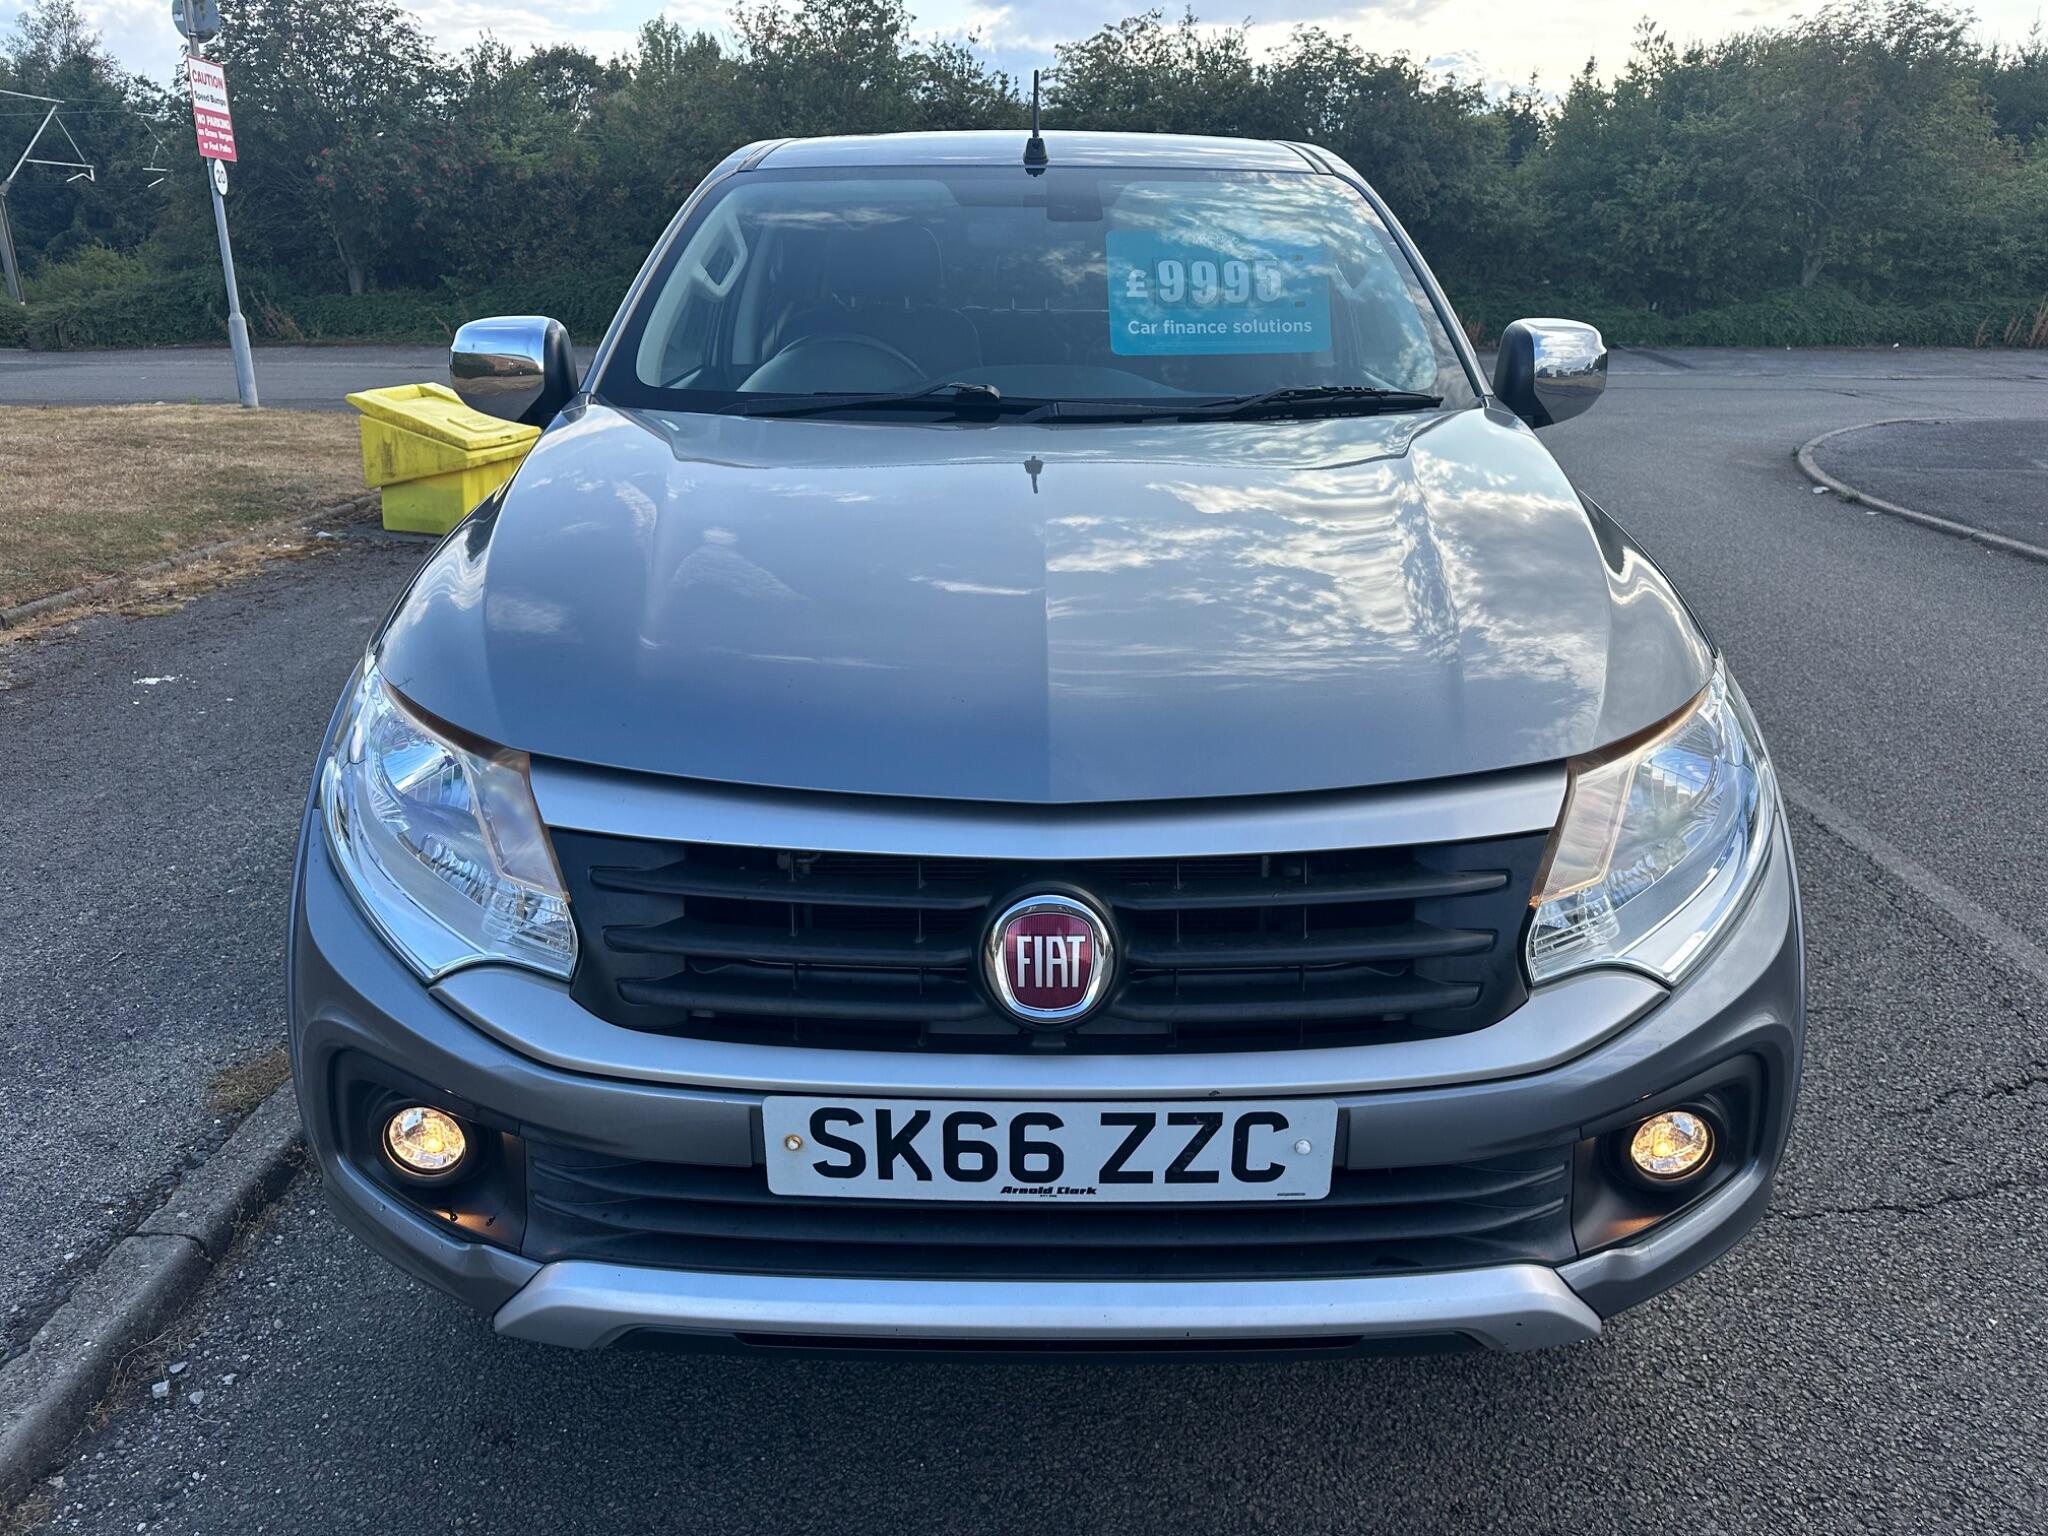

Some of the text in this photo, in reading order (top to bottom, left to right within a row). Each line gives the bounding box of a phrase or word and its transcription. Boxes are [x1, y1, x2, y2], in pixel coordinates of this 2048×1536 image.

[196, 113, 206, 125] NO
[1127, 318, 1312, 335] Car finance solutions
[1016, 935, 1086, 989] FIAT
[808, 1106, 1290, 1184] SK66 ZZC
[1000, 1186, 1054, 1195] Arnold
[1056, 1186, 1097, 1196] Clark
